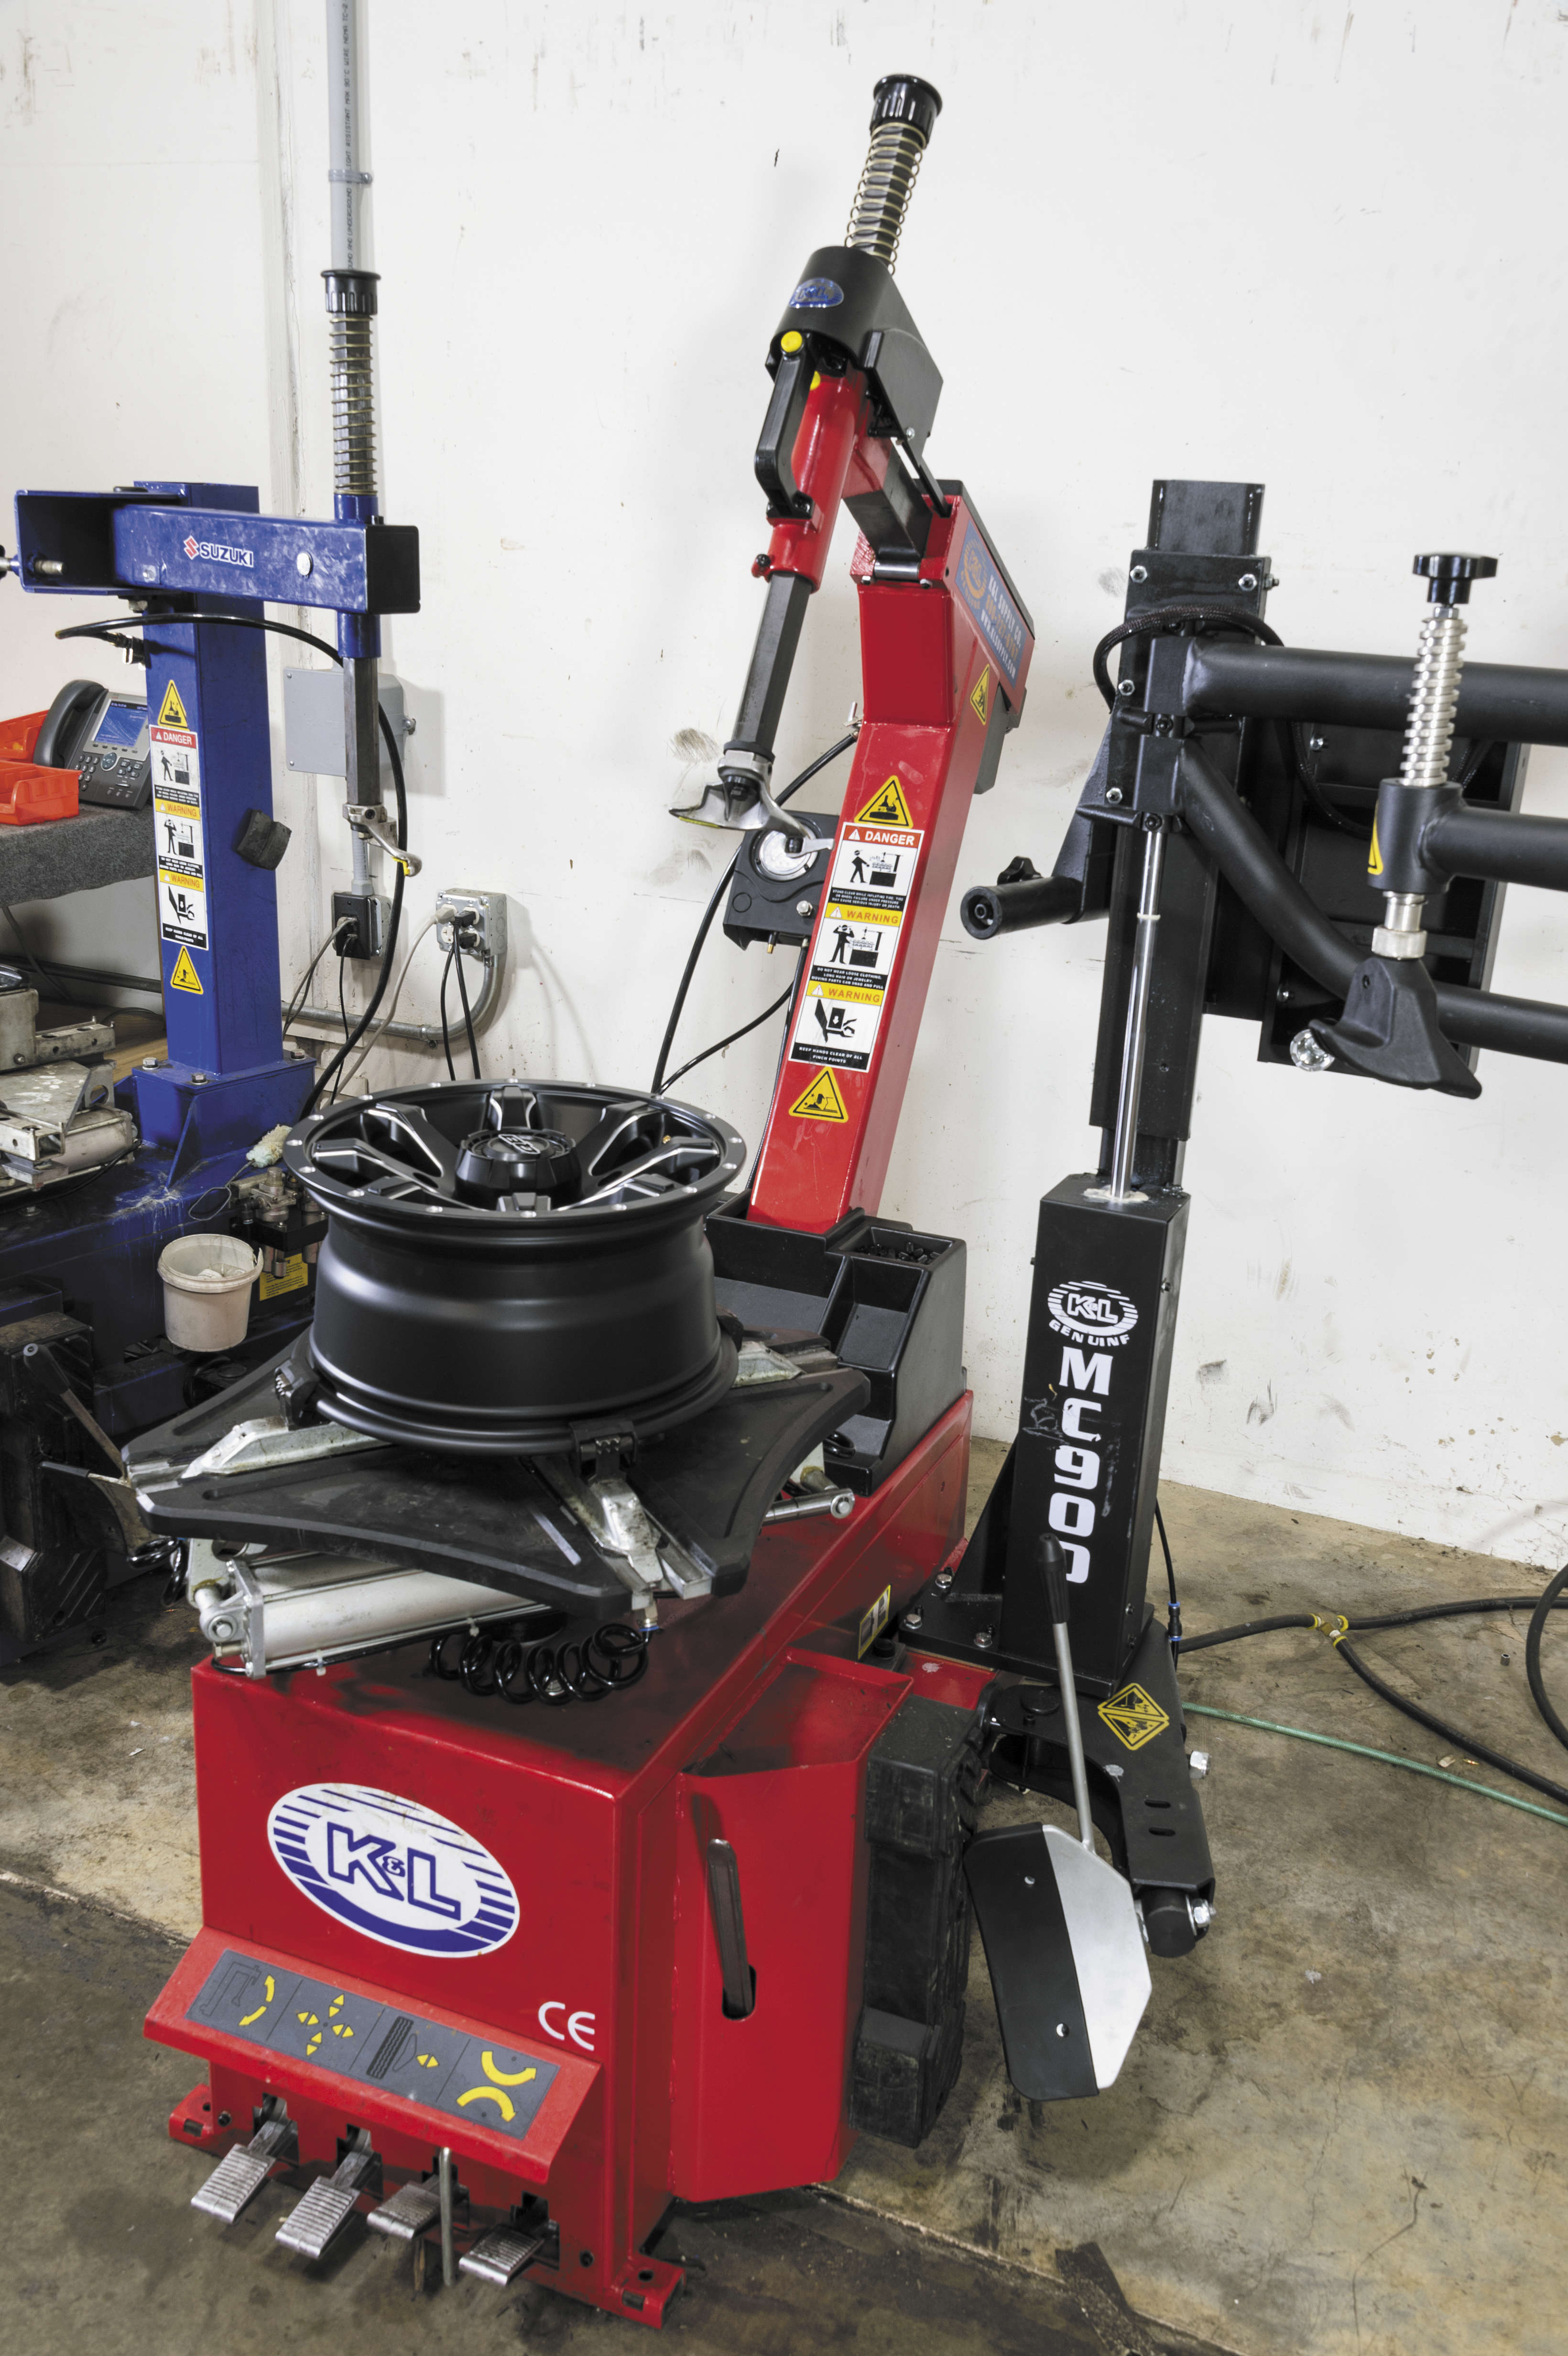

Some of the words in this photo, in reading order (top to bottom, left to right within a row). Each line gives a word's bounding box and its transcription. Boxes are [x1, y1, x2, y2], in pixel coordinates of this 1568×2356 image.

[200, 542, 253, 567] SUZUKI
[998, 593, 1015, 633] SUPPLY
[163, 731, 192, 745] DANGER
[168, 804, 197, 817] WARNING
[865, 831, 915, 846] DANGER
[171, 874, 200, 888] WARNING
[847, 910, 899, 924] WARNING
[828, 988, 880, 1003] WARNING
[327, 1821, 461, 1921] K&L
[538, 2001, 596, 2051] CE
